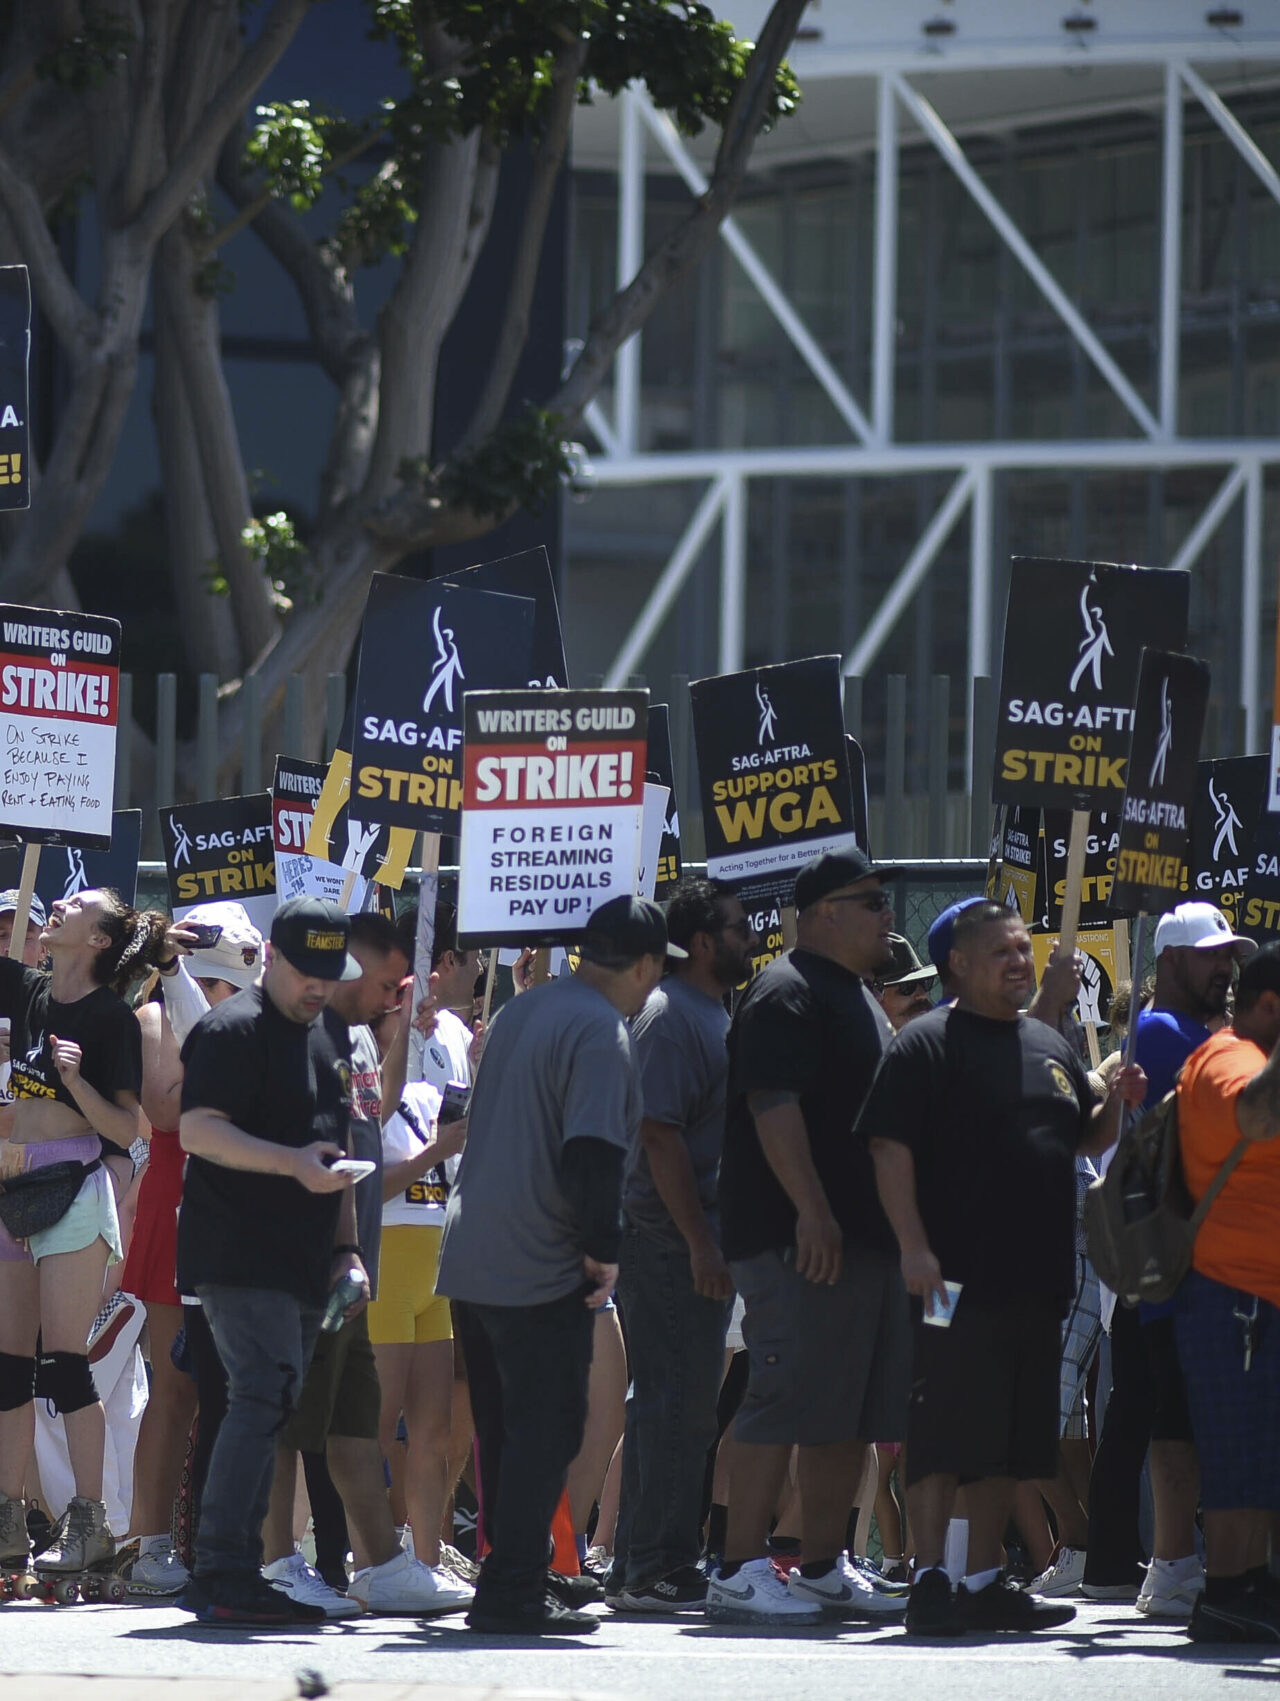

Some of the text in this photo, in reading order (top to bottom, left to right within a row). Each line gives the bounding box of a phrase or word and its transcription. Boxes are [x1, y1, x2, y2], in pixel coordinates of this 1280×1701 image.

[3, 622, 113, 655] WRITERS GUILD
[50, 652, 66, 667] ON
[1, 665, 110, 717] STRIKE!
[477, 707, 636, 734] WRITERS GUILD
[1007, 699, 1135, 731] SAG·AFT
[6, 724, 80, 747] ON STRIKE
[363, 716, 462, 752] SAG·AF
[546, 736, 567, 752] ON
[1069, 734, 1102, 753] ON
[6, 749, 88, 766] BECAUSE I
[422, 755, 453, 775] ON
[1001, 748, 1128, 789] STRIK
[4, 770, 91, 791] ENJOY PAYING
[278, 770, 322, 795] WRITERS
[356, 765, 464, 811] STRIK
[475, 751, 633, 802] STRIKE!
[712, 758, 838, 802] SUPPORTS
[1, 791, 26, 808] RENT
[39, 792, 76, 810] EATING
[79, 796, 101, 810] FOOD
[715, 785, 841, 844] WGA
[195, 823, 274, 852] SAG·AFT
[492, 823, 613, 844] FOREIGN
[1144, 832, 1160, 850] ON
[227, 848, 254, 863] ON
[490, 847, 614, 870] STREAMING
[719, 862, 744, 874] Acting
[744, 854, 778, 869] Together
[778, 853, 789, 863] for
[791, 853, 796, 861] a
[797, 847, 821, 860] Better
[177, 861, 276, 900] STRIK
[1118, 849, 1181, 889] STRIKE!
[323, 886, 341, 896] DARE
[490, 871, 612, 893] RESIDUALS
[509, 897, 550, 917] PAY
[306, 933, 346, 950] TEAMSTERS
[767, 931, 784, 949] ON
